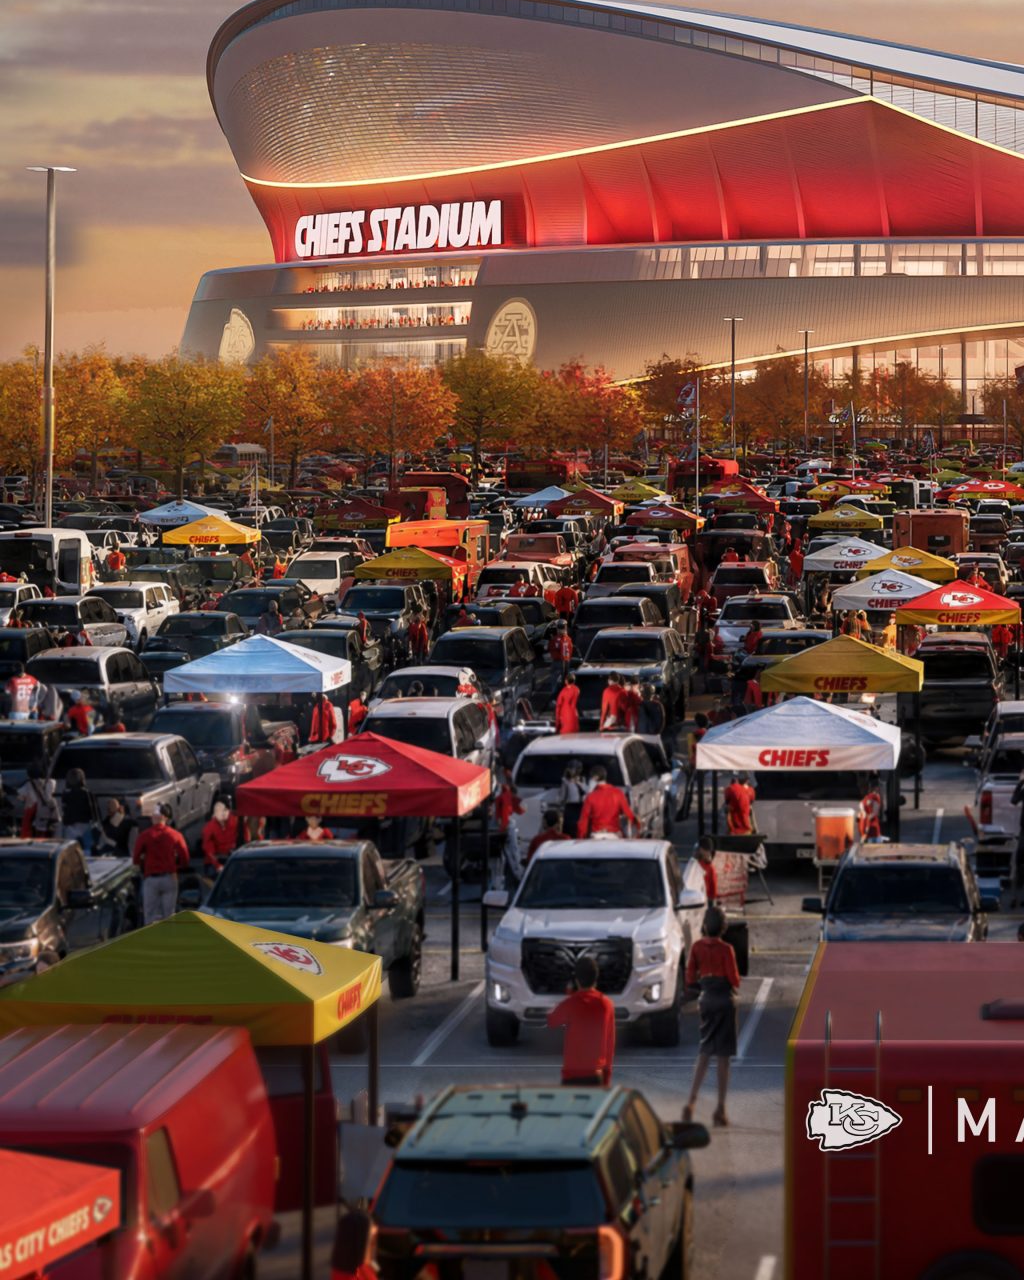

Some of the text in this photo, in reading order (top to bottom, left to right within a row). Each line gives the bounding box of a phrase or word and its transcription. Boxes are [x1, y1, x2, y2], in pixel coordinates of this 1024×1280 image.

[295, 200, 502, 258] CHIEFS STADIUM
[188, 535, 220, 543] CHIEFS
[385, 568, 418, 577] CHIEFS
[937, 612, 981, 623] CHIEFS
[813, 676, 868, 691] CHIEFS
[758, 749, 830, 768] CHIEFS
[301, 793, 387, 815] CHIEFS
[15, 1227, 46, 1263] CITY
[48, 1205, 90, 1246] CHIEFS
